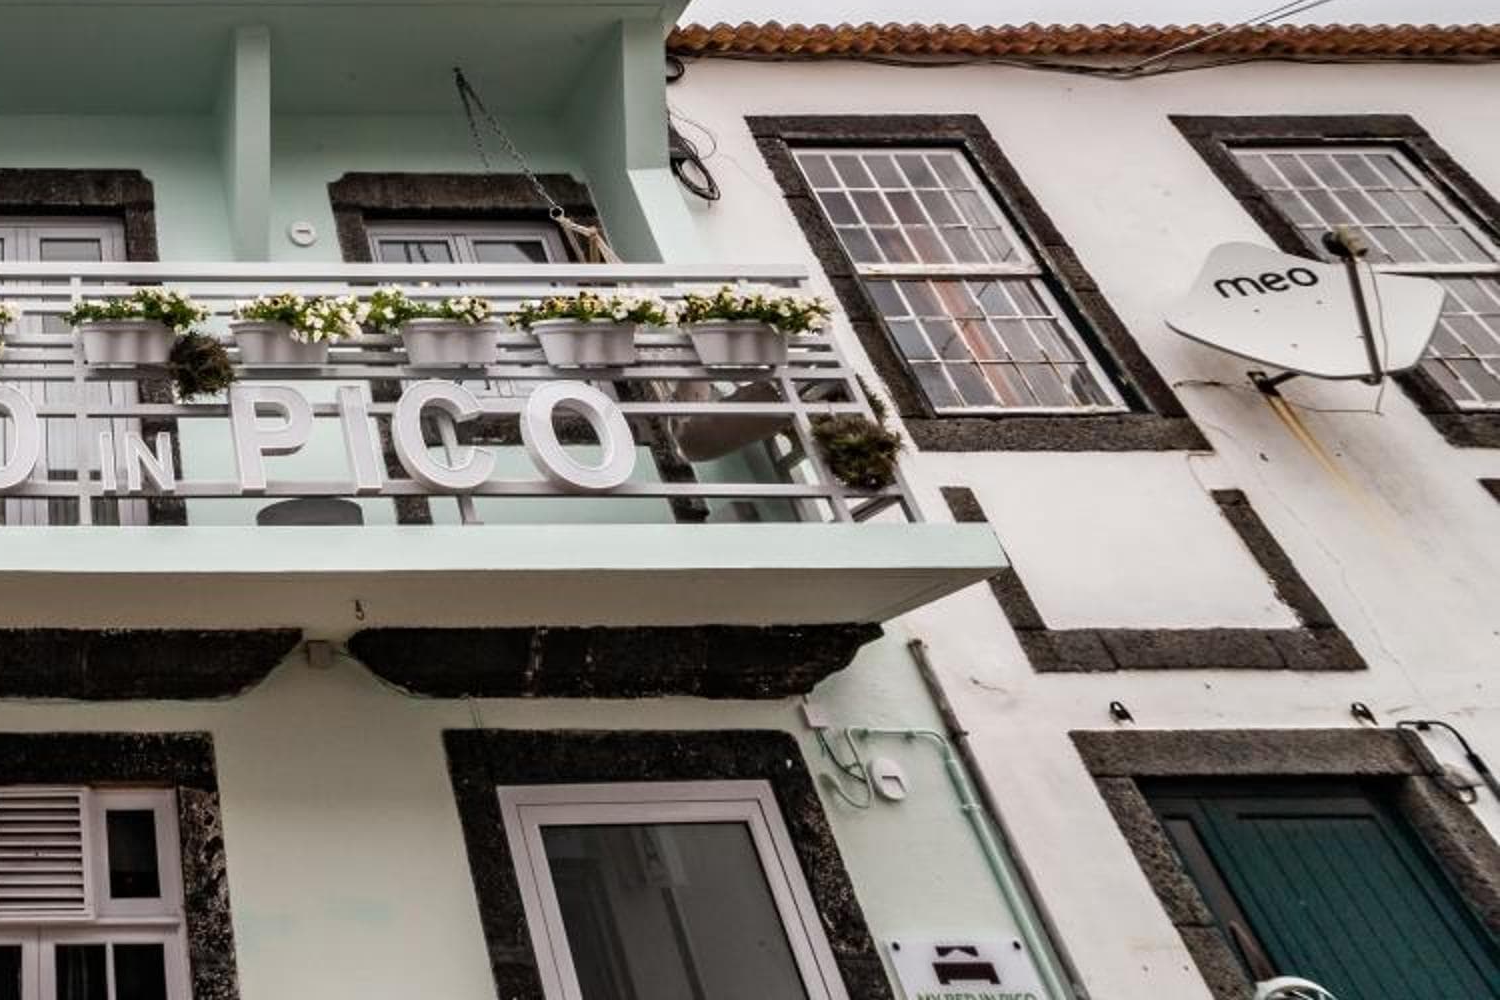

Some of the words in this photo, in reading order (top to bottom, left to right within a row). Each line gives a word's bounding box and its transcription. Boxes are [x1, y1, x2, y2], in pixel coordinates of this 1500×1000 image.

[1214, 267, 1319, 298] meo
[99, 430, 176, 494] IN
[227, 379, 636, 495] PICO
